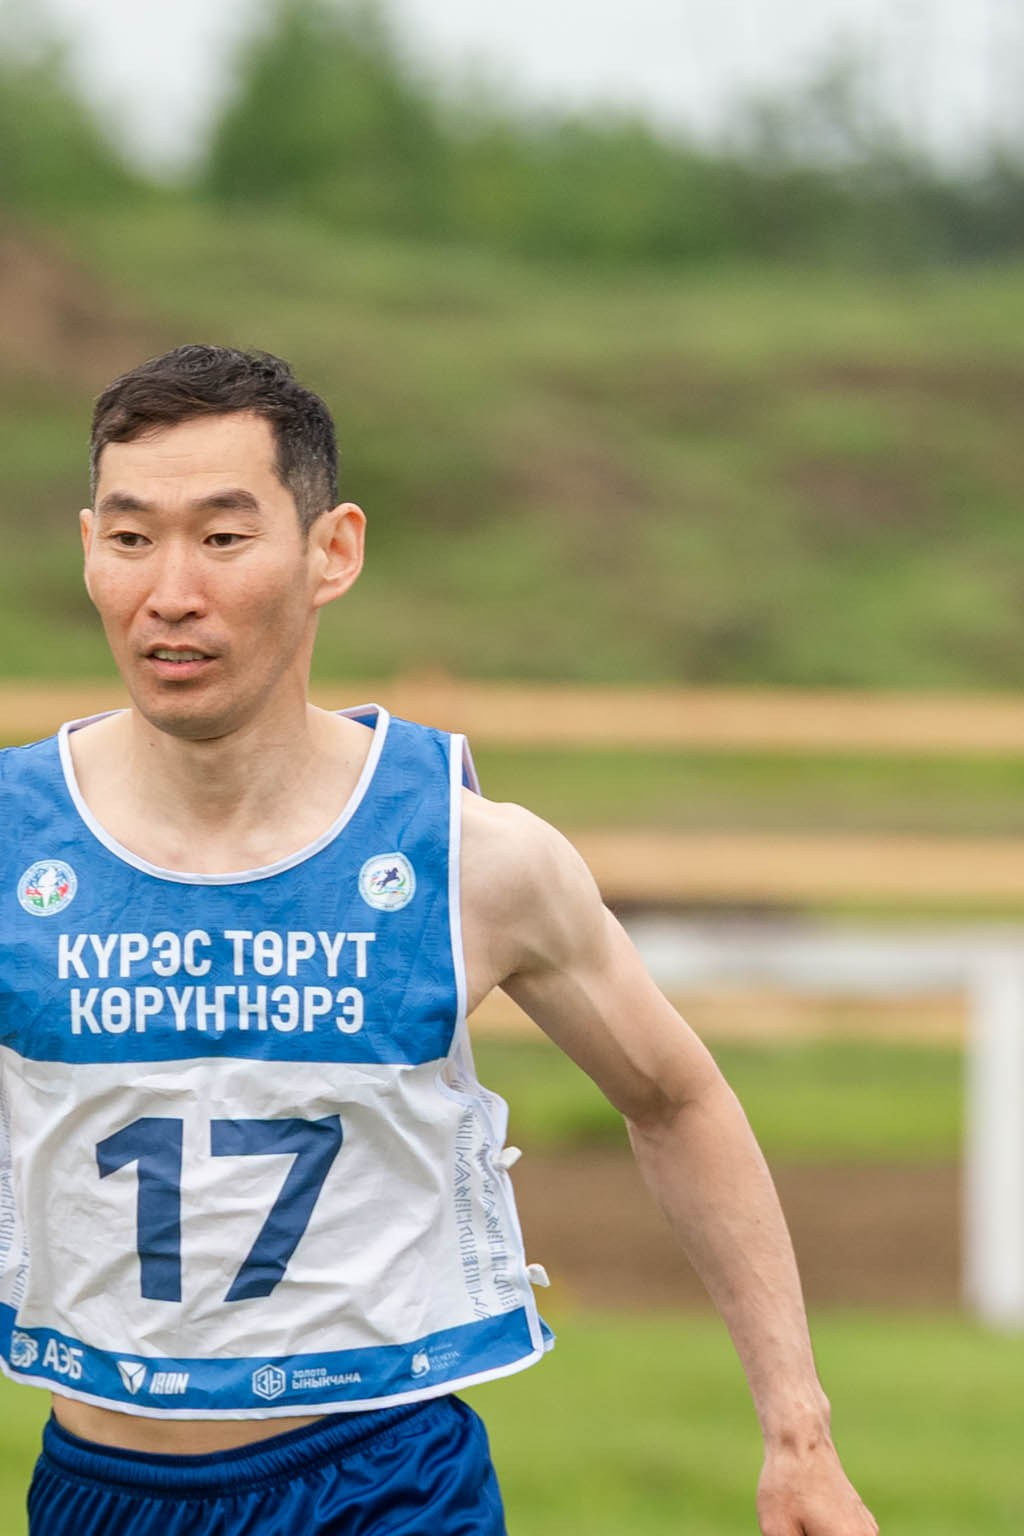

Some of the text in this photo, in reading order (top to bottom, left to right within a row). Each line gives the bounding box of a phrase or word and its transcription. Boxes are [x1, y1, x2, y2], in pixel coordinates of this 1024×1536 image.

[57, 930, 376, 980] КҮРЭС ТӨРҮТ
[95, 1113, 344, 1303] 17
